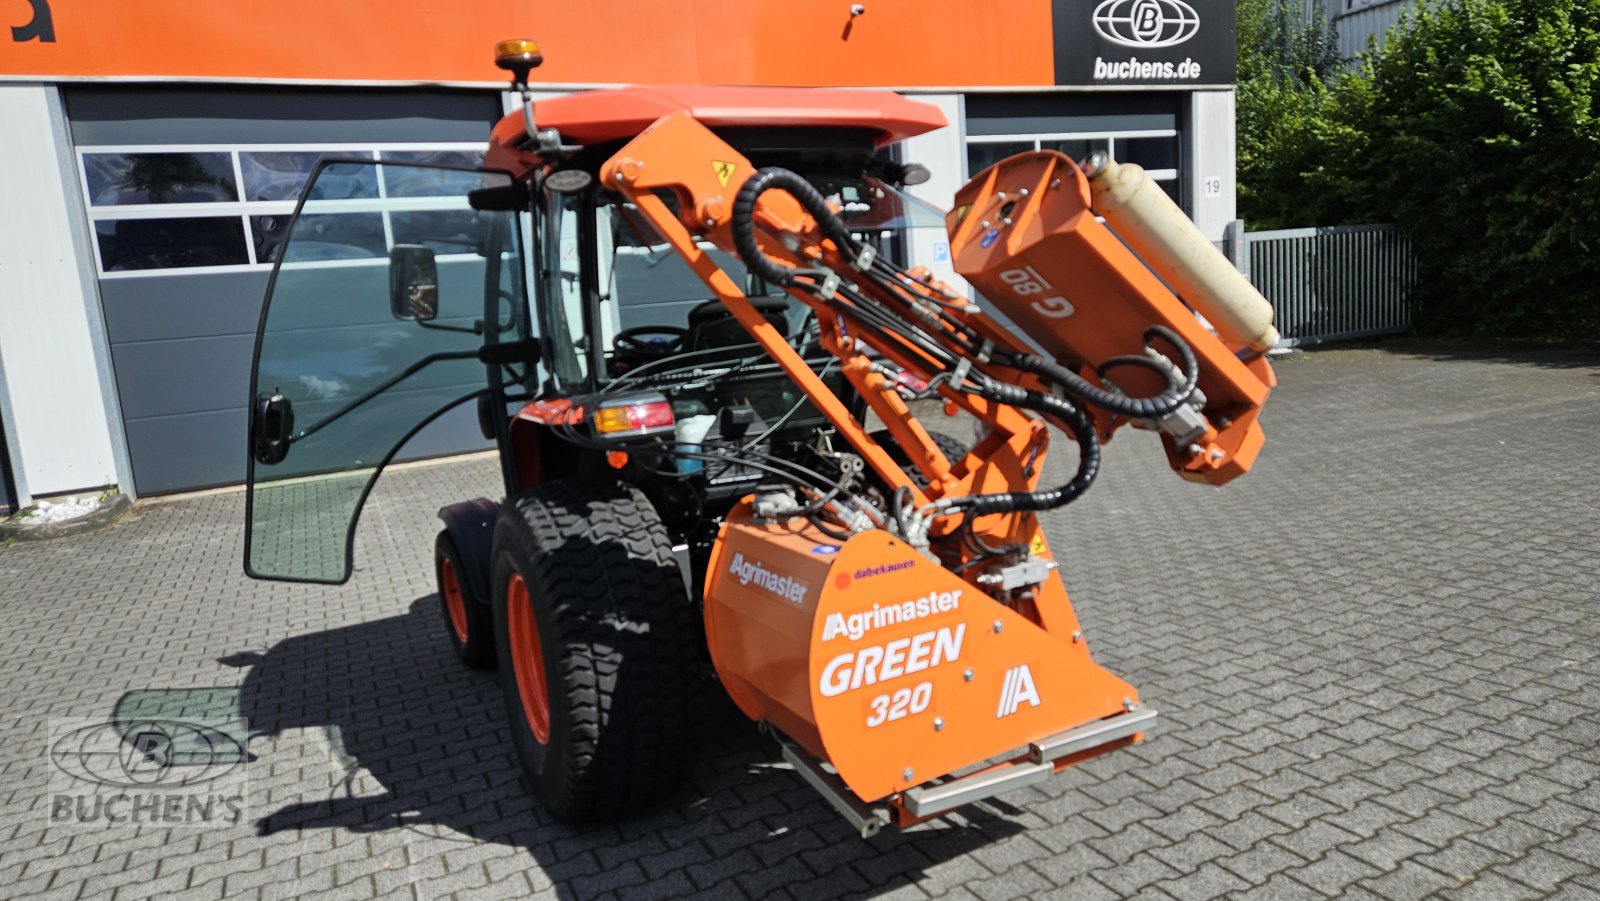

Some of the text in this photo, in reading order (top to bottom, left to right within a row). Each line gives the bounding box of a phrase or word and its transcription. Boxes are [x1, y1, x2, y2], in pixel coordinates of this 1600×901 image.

[1093, 56, 1201, 79] buchens.de
[1206, 179, 1220, 193] 19
[1000, 268, 1075, 318] G 80
[729, 553, 807, 604] Agrimaster
[822, 590, 962, 641] Agrimaster
[819, 623, 967, 698] GREEN
[866, 682, 933, 728] 320
